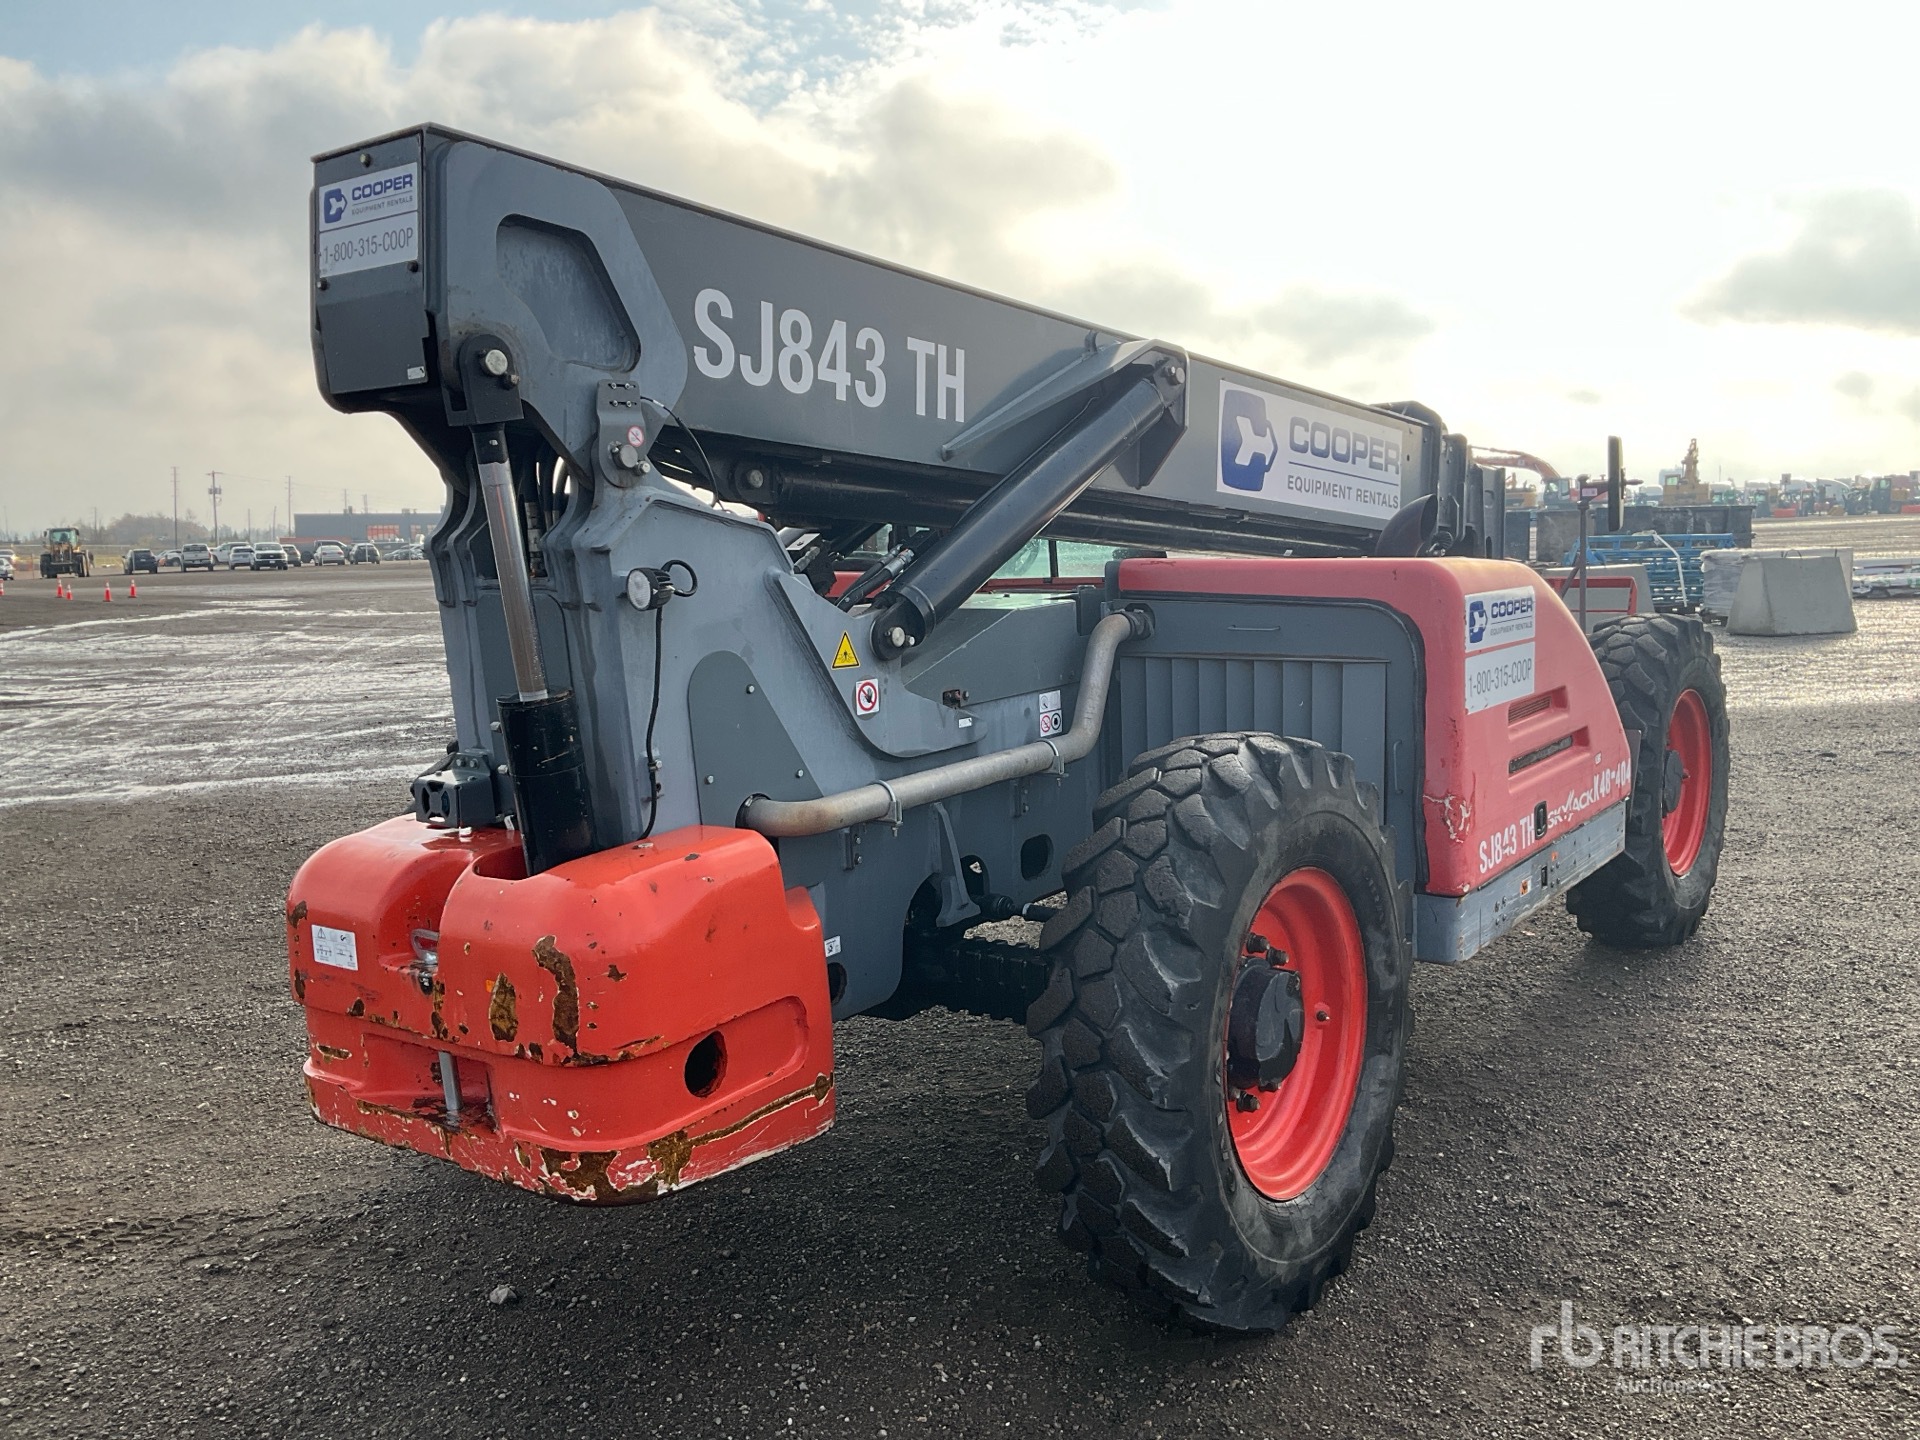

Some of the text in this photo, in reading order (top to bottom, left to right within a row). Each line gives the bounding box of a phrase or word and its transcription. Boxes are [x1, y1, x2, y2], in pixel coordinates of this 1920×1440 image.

[352, 173, 413, 201] COOPER
[352, 195, 413, 216] EQUIPMENT RENTALS
[323, 227, 413, 264] 1-800-315-COOP
[693, 288, 965, 423] SJ843 TH
[1289, 416, 1400, 475] COOPER
[1287, 474, 1399, 509] EQUIPMENT RENTALS
[1491, 597, 1533, 619] COOPER
[1490, 621, 1533, 636] EQUIPMENT RENTALS
[1468, 658, 1532, 698] 1-800-315-COOP
[1479, 823, 1517, 874] SJ843
[1520, 812, 1536, 850] TH
